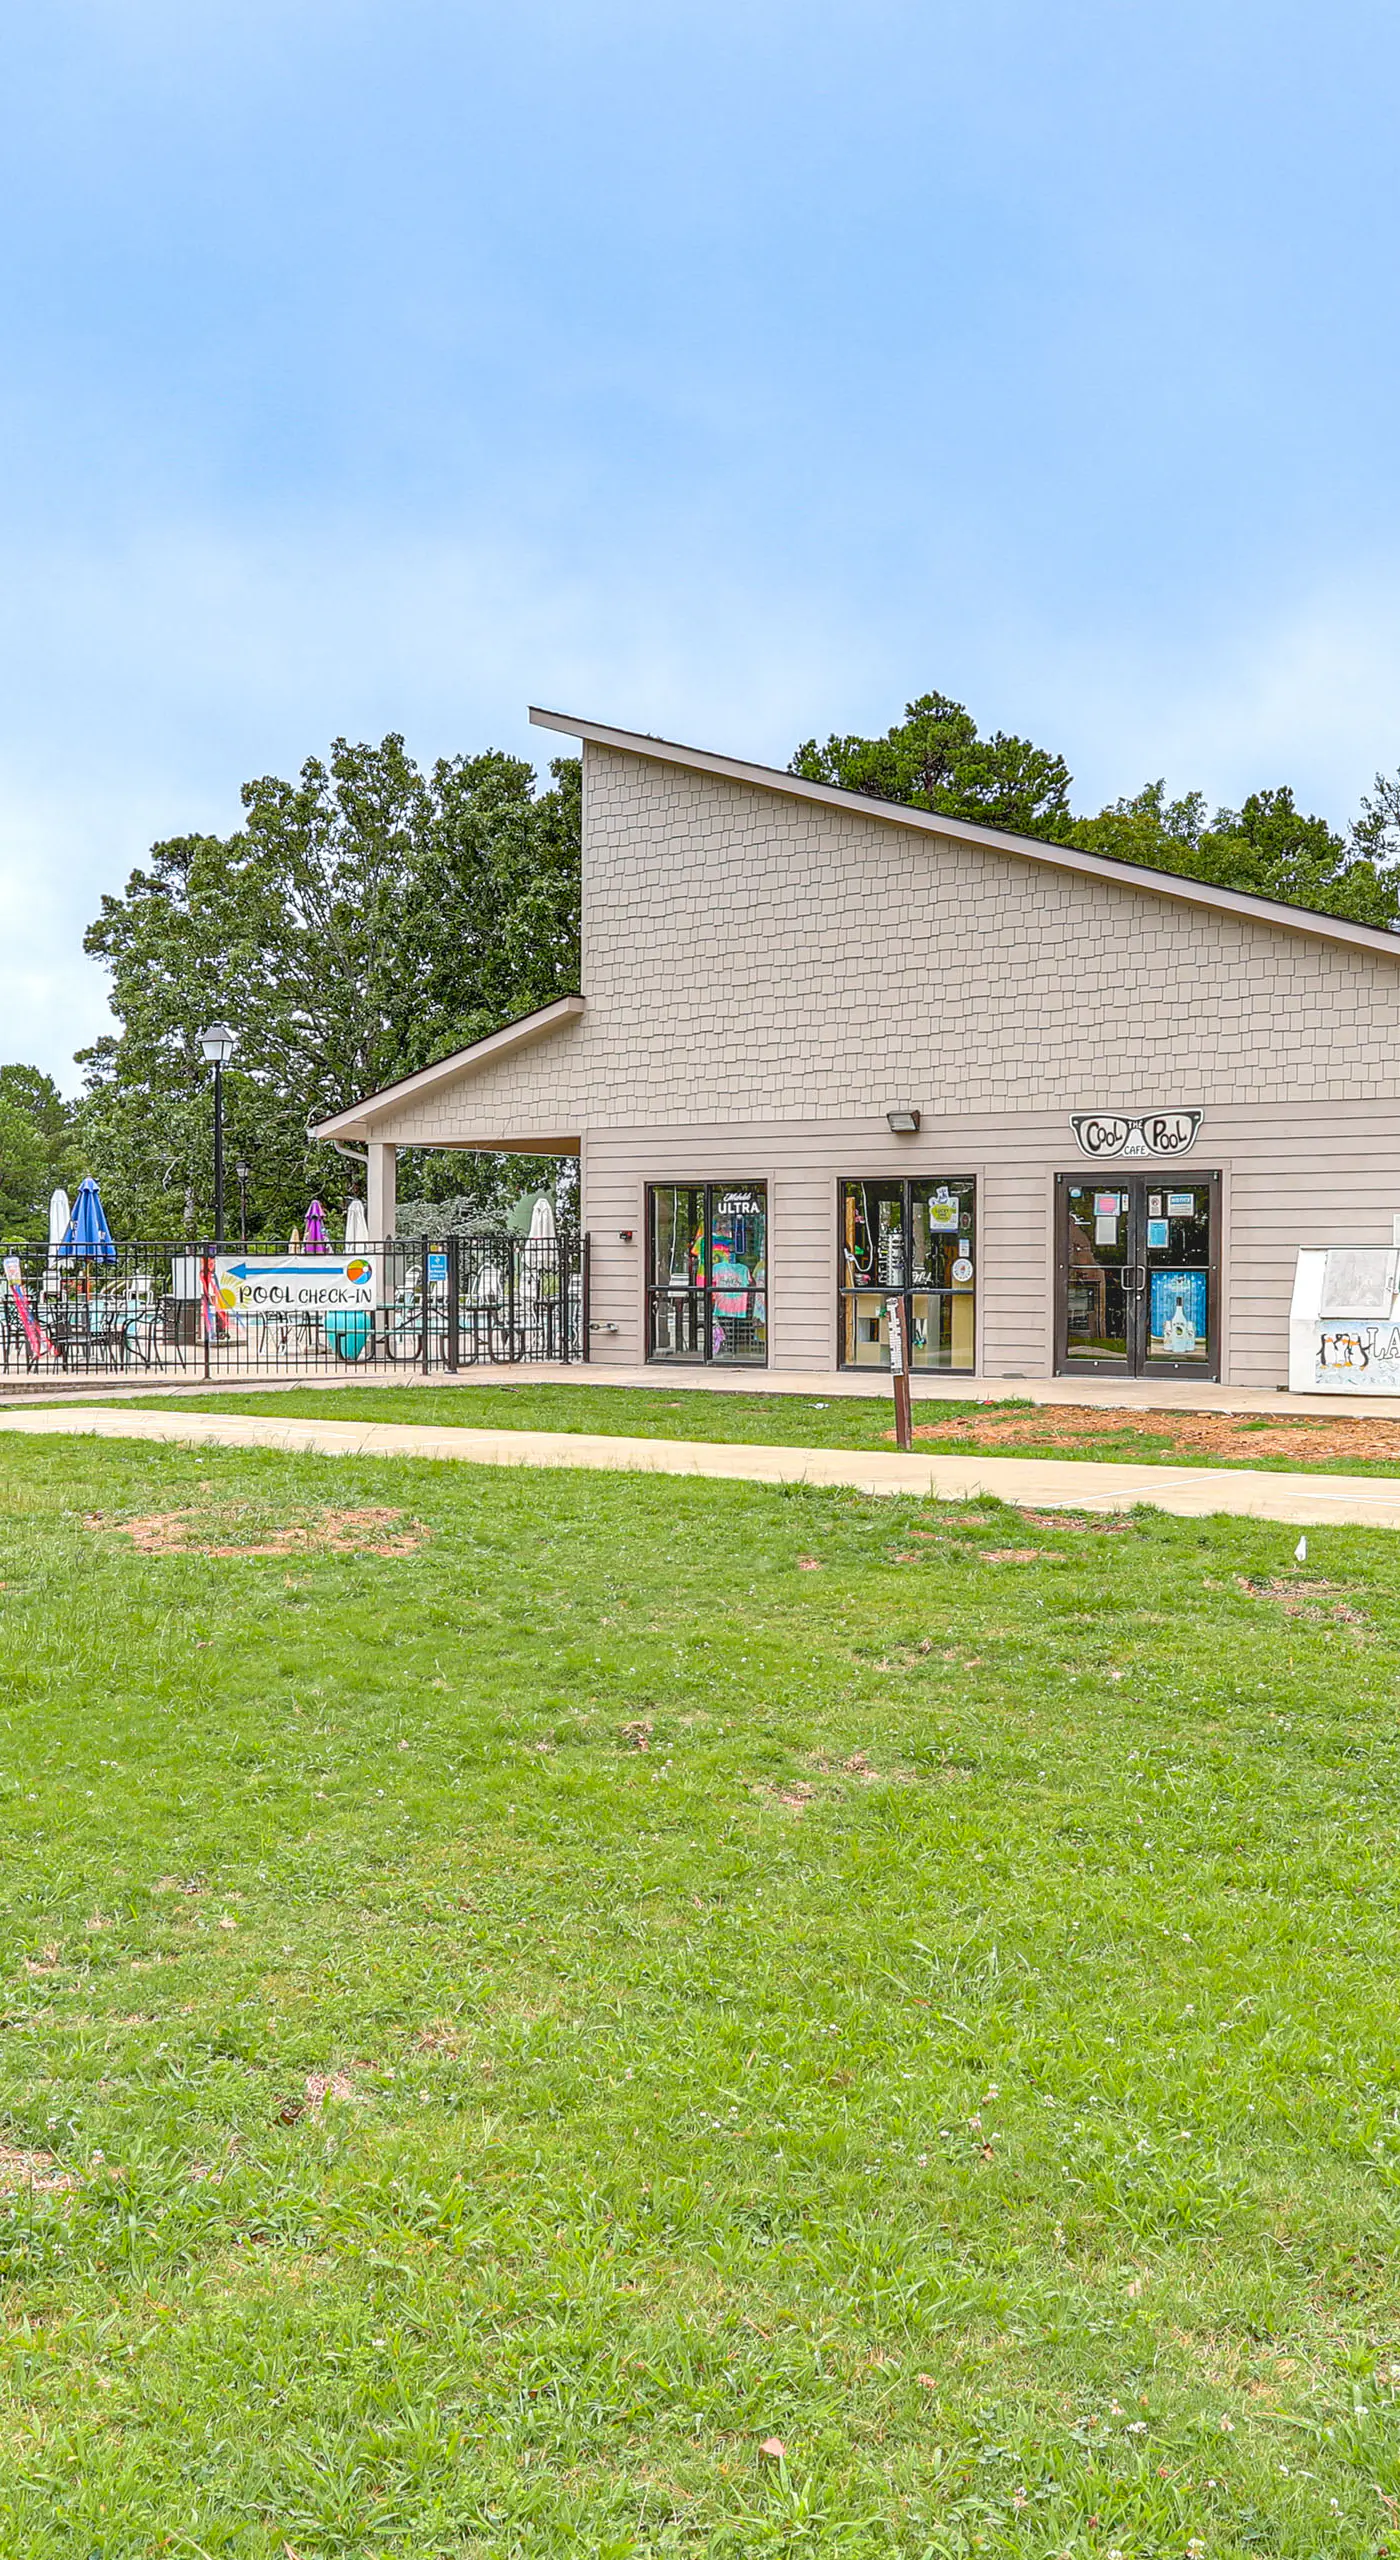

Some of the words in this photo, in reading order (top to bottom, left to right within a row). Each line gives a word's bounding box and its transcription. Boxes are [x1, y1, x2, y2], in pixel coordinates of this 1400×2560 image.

[1128, 1120, 1143, 1129] THE
[1124, 1145, 1146, 1155] CAFE
[718, 1202, 760, 1214] ULTRA
[239, 1286, 295, 1304] POOL
[298, 1288, 372, 1304] CHECK-IN
